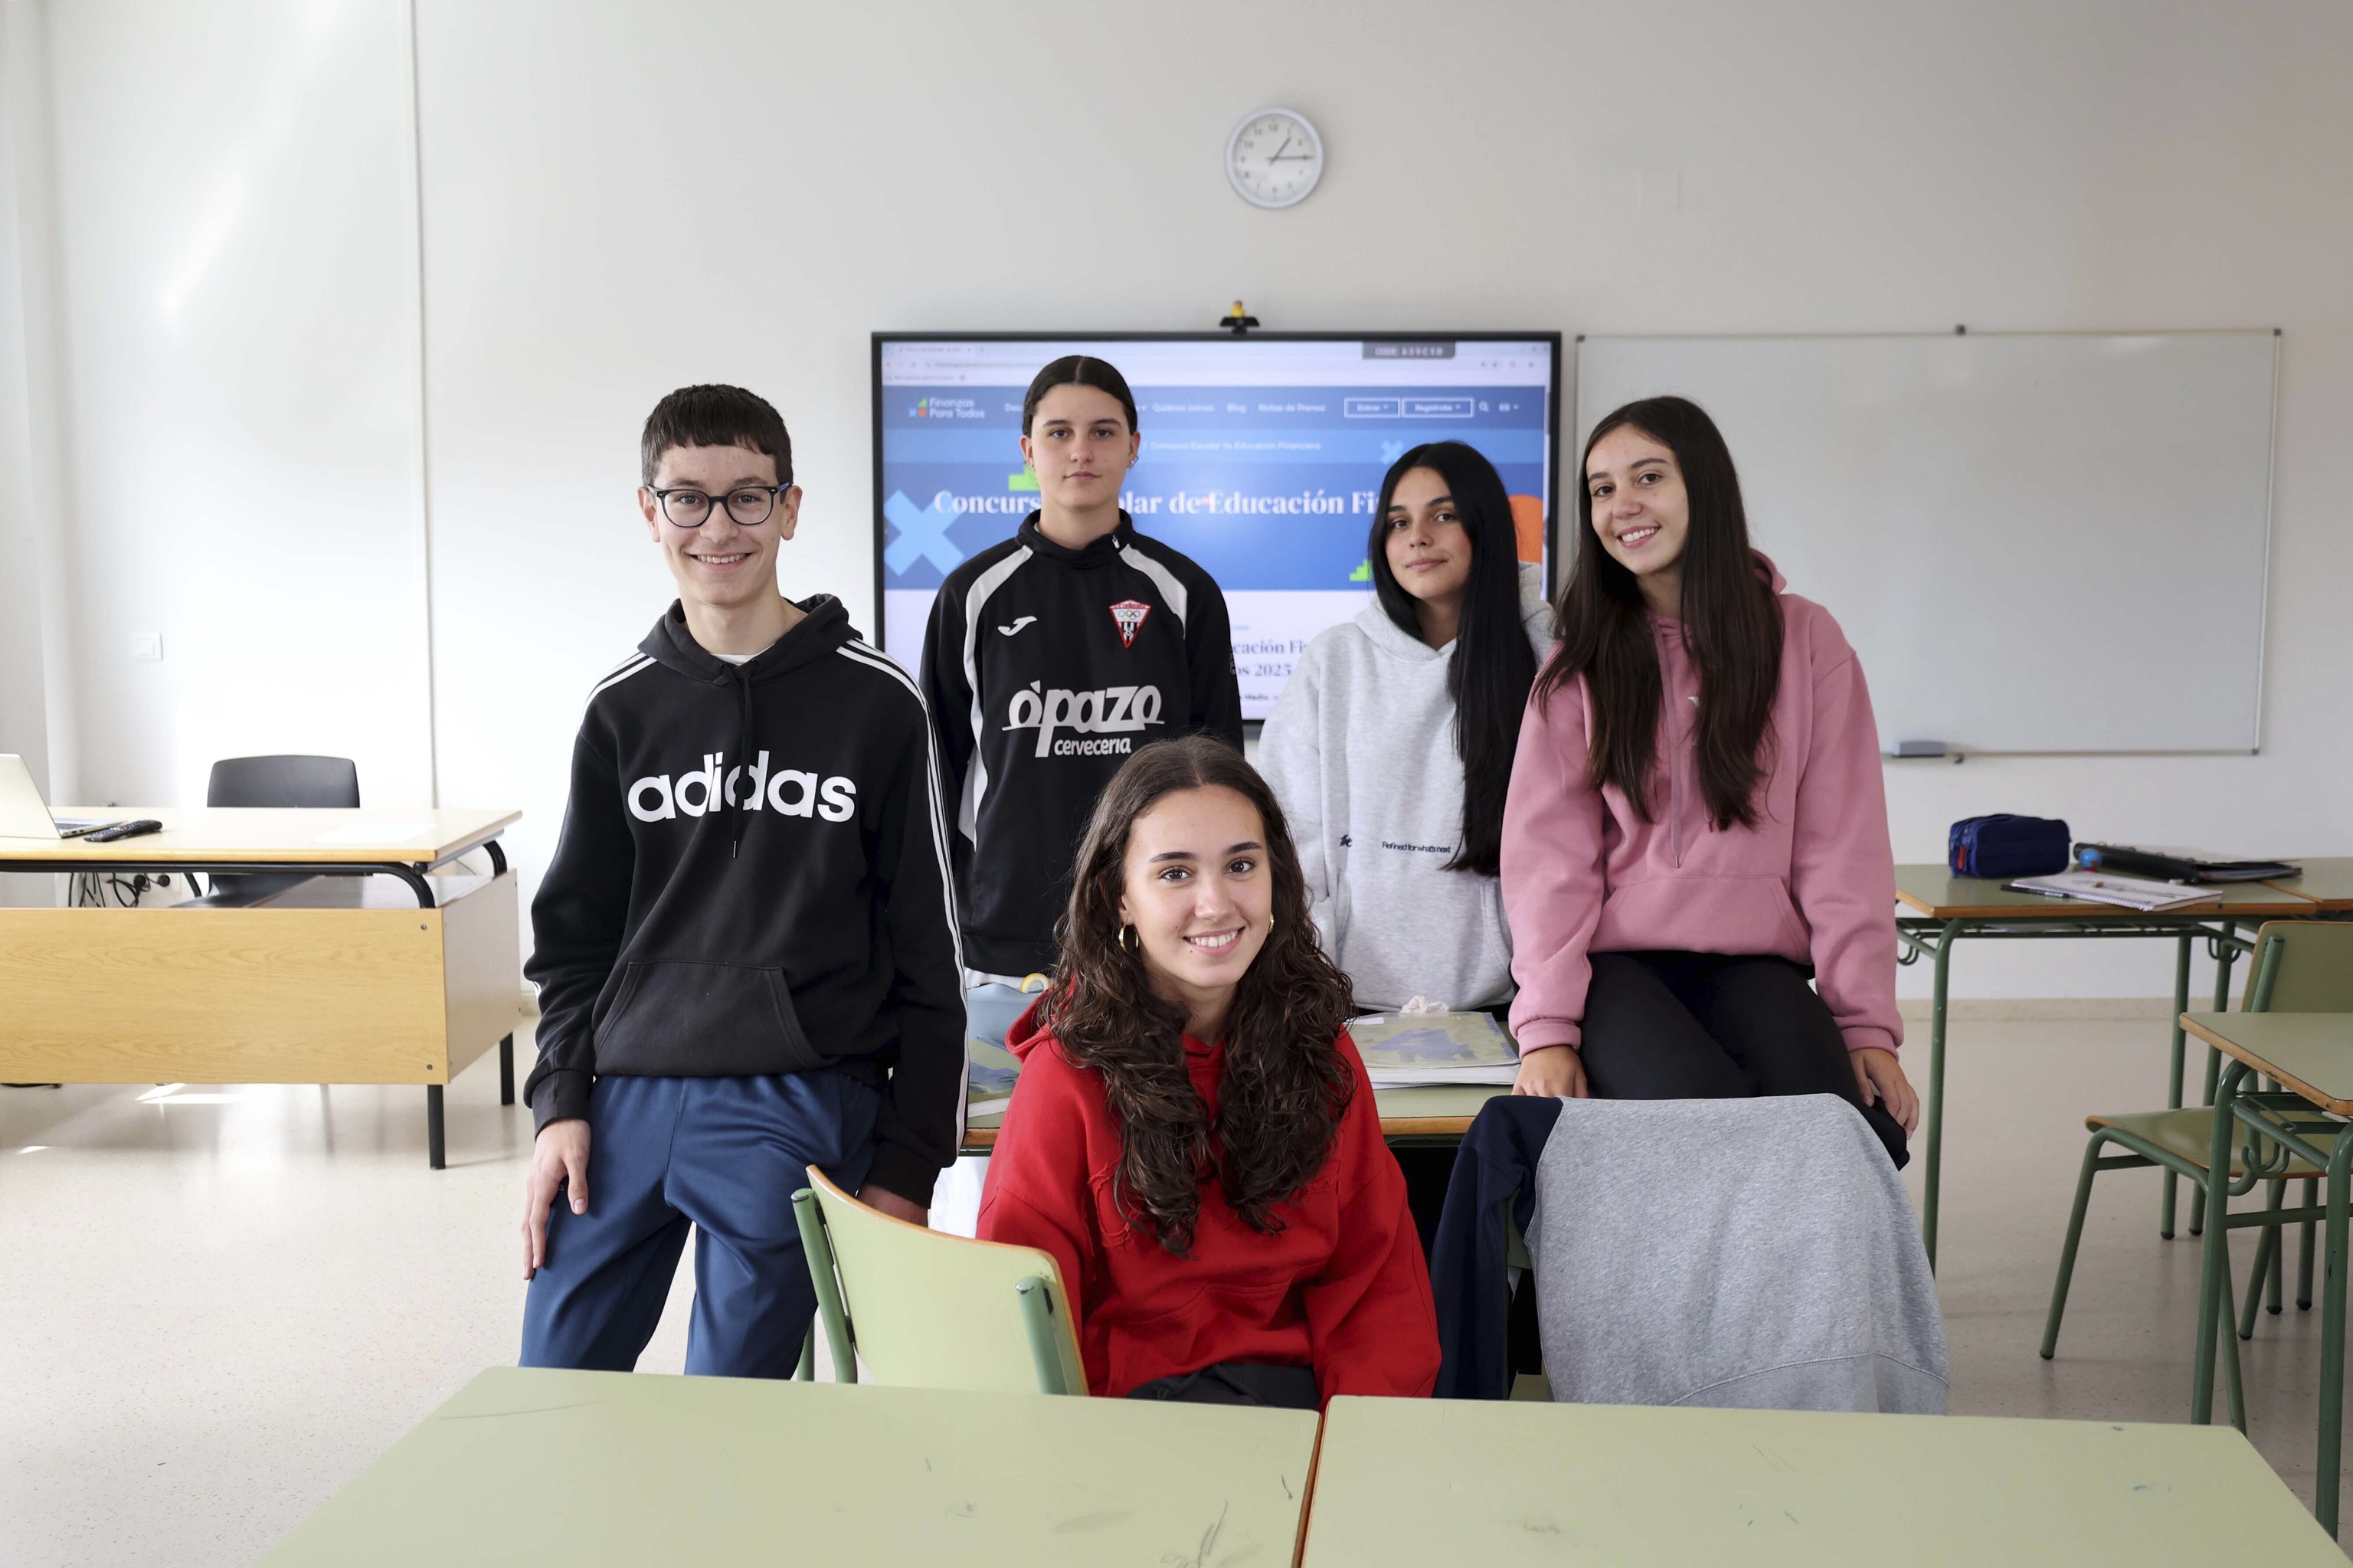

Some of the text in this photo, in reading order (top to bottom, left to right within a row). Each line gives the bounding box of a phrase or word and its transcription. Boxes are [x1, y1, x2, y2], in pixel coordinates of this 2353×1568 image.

[929, 398, 974, 408] Finanzas
[929, 408, 986, 418] Para Todos
[934, 490, 1041, 514] Concurs
[1168, 490, 1201, 514] de
[1208, 488, 1344, 514] Educación
[1351, 490, 1379, 514] Fi
[1232, 639, 1306, 654] cación Fi
[1255, 663, 1291, 676] 2025
[627, 750, 857, 823] adidas
[1382, 841, 1407, 851] Refined
[1407, 843, 1416, 852] for
[1436, 845, 1451, 853] next
